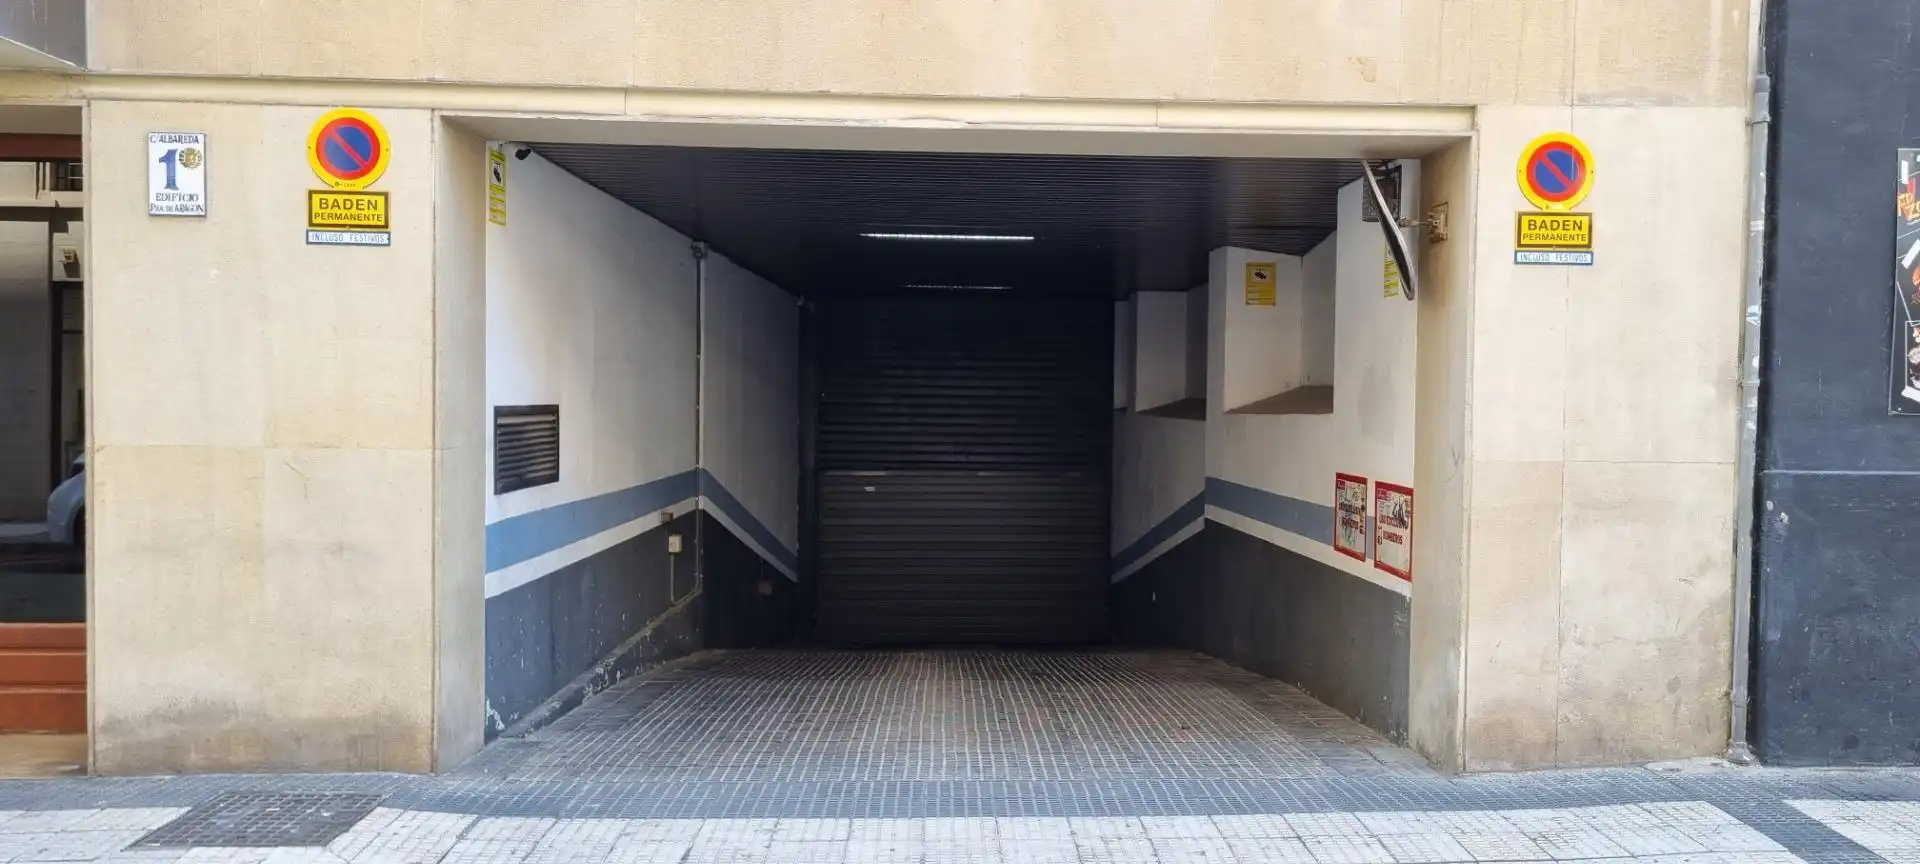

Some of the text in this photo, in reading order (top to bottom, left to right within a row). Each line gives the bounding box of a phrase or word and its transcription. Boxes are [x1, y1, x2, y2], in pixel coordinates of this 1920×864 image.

[155, 192, 199, 202] EDIFICIO
[319, 198, 377, 211] BADEN
[314, 212, 382, 222] PERMANENTE
[1528, 219, 1582, 231] BADEN
[312, 232, 384, 243] INCLUSO FESTIVOS
[1523, 232, 1586, 242] PERMANENTE
[1521, 252, 1588, 263] INCLUSO FESTIVOS
